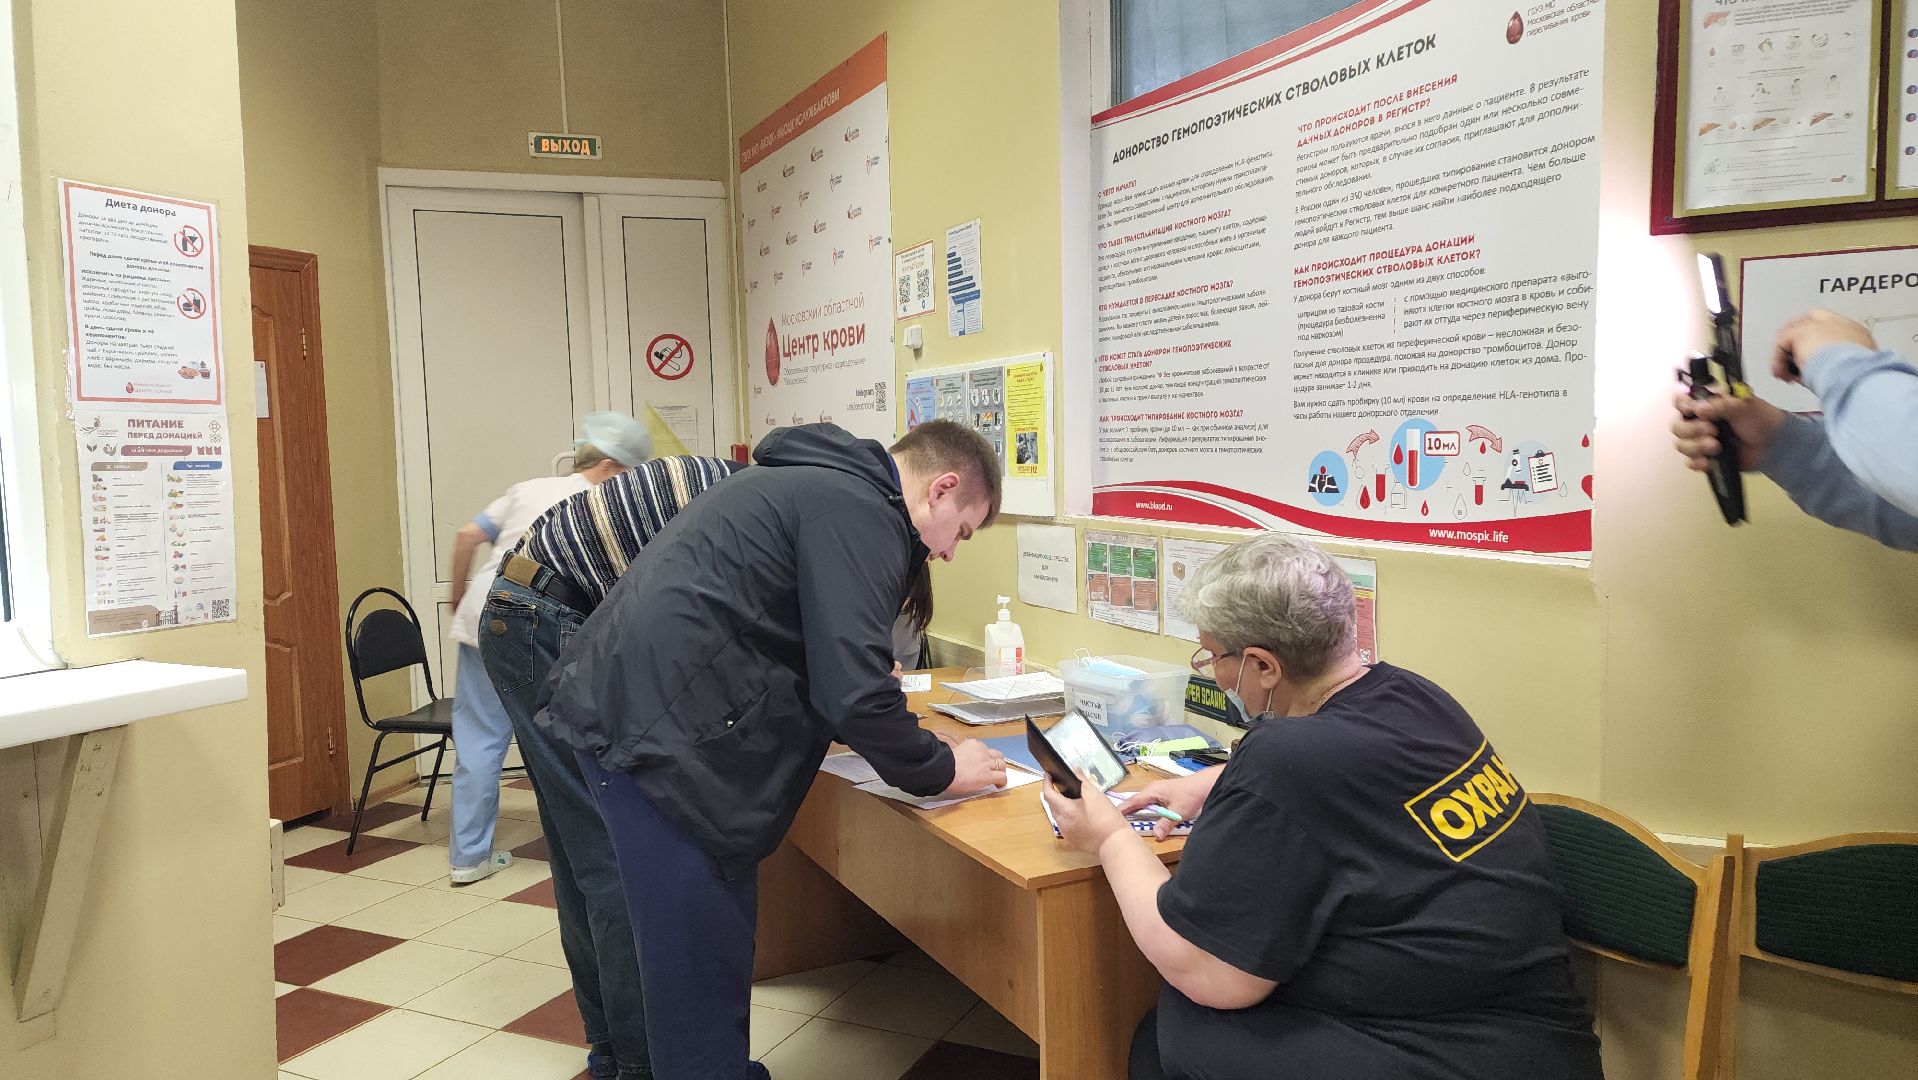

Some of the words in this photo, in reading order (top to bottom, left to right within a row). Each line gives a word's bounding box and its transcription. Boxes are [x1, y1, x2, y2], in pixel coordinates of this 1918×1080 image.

[1570, 10, 1590, 22] крови
[1112, 133, 1169, 163] ДОНОРСТВО
[1171, 92, 1281, 140] ГЕМОПОЭТИЧЕСКИХ
[1285, 58, 1370, 100] СТВОЛОВЫХ
[1376, 34, 1435, 68] КЛЕТОК
[1297, 122, 1312, 133] ЧТО
[1314, 103, 1370, 128] ПРОИСХОДИТ
[1373, 92, 1403, 108] ПОСЛЕ
[1406, 74, 1457, 98] ВНЕСЕНИЯ
[1423, 113, 1440, 124] него
[1441, 103, 1473, 120] данные
[1483, 88, 1526, 106] пациенте.
[1537, 69, 1589, 92] результате
[1297, 129, 1331, 147] ДАННЫХ
[1333, 116, 1375, 137] ДОНОРОВ
[1385, 98, 1430, 119] РЕГИСТР?
[1419, 122, 1457, 138] подобран
[1459, 115, 1480, 128] один
[1483, 110, 1498, 120] или
[1501, 96, 1548, 115] несколько
[1550, 86, 1584, 101] совме-
[1425, 135, 1462, 150] согласия,
[1463, 119, 1515, 140] приглашают
[1517, 114, 1535, 127] для
[1537, 103, 1583, 121] дополни-
[541, 139, 590, 155] ВЫХОД
[1442, 159, 1496, 177] типирование
[1497, 146, 1548, 164] становится
[1550, 135, 1595, 154] донором
[1412, 189, 1427, 200] для
[1429, 177, 1479, 195] конкретного
[1481, 167, 1524, 182] пациента.
[1527, 162, 1545, 172] Чем
[1548, 152, 1585, 167] больше
[1431, 196, 1454, 208] найти
[1457, 187, 1497, 201] наиболее
[1499, 173, 1561, 192] подходящего
[105, 199, 138, 212] Диета
[140, 204, 177, 218] донора
[1293, 268, 1373, 287] ГЕМОПОЭТИЧЕСКИХ
[1376, 257, 1433, 274] СТВОЛОВЫХ
[1437, 248, 1480, 264] КЛЕТОК?
[1294, 264, 1309, 275] КАК
[1311, 254, 1366, 271] ПРОИСХОДИТ
[1369, 245, 1422, 261] ПРОЦЕДУРА
[1425, 235, 1474, 252] ДОНАЦИИ
[1425, 273, 1444, 284] двух
[1446, 266, 1486, 279] способов:
[1449, 282, 1508, 296] медицинского
[1510, 275, 1557, 289] препарата
[1560, 270, 1593, 281] «выго-
[1819, 272, 1918, 294] ГАРДЕРО
[781, 307, 821, 327] Московский
[824, 292, 865, 316] областной
[1428, 303, 1454, 312] клетки
[1456, 297, 1492, 308] костного
[1494, 294, 1519, 304] мозга
[1529, 290, 1555, 301] кровь
[1566, 283, 1595, 295] соби-
[1434, 315, 1460, 324] оттуда
[1462, 312, 1485, 322] через
[1487, 303, 1563, 318] периферическую
[1566, 300, 1588, 309] вену
[783, 333, 819, 362] Центр
[823, 323, 865, 356] крови
[1461, 333, 1486, 342] крови
[1495, 327, 1544, 338] несложная
[1555, 322, 1582, 332] безо-
[1437, 347, 1481, 358] донорство
[1484, 341, 1544, 354] тромбоцитов.
[1545, 339, 1577, 350] Донор
[1450, 360, 1488, 370] донацию
[1490, 358, 1519, 366] клеток
[1534, 354, 1561, 365] дома.
[1564, 351, 1588, 362] Про-
[1442, 392, 1496, 402] определение
[1499, 389, 1559, 399] HLA-генотипа
[127, 419, 185, 429] ПИТАНИЕ
[127, 432, 154, 440] ПЕРЕД
[156, 431, 203, 441] ДОНАЦИЕЙ
[1427, 437, 1440, 450] 10
[1428, 525, 1508, 544] www.mospk.life
